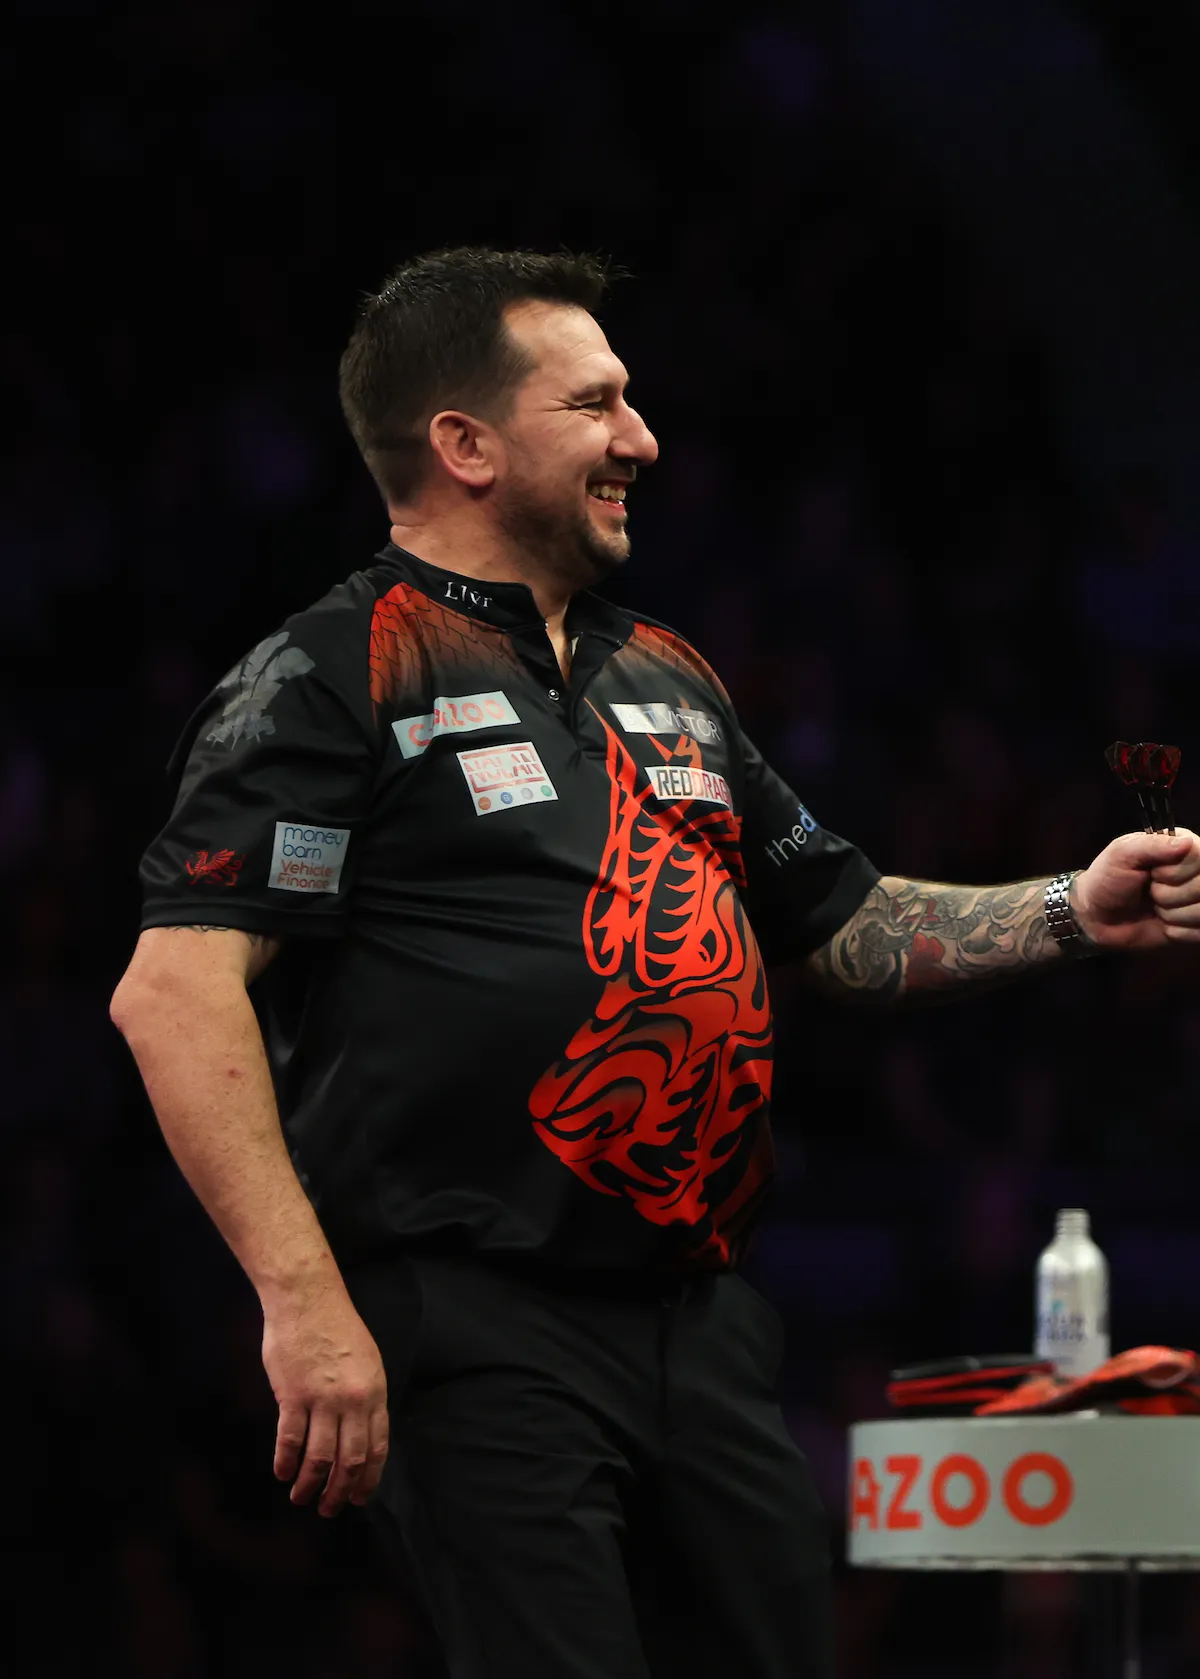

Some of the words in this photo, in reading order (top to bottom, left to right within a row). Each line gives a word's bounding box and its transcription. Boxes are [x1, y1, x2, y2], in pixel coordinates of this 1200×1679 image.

[660, 709, 722, 741] VICTOR
[283, 826, 344, 849] money
[282, 838, 322, 860] barn
[281, 859, 334, 878] Vehicle
[277, 872, 330, 889] Finance
